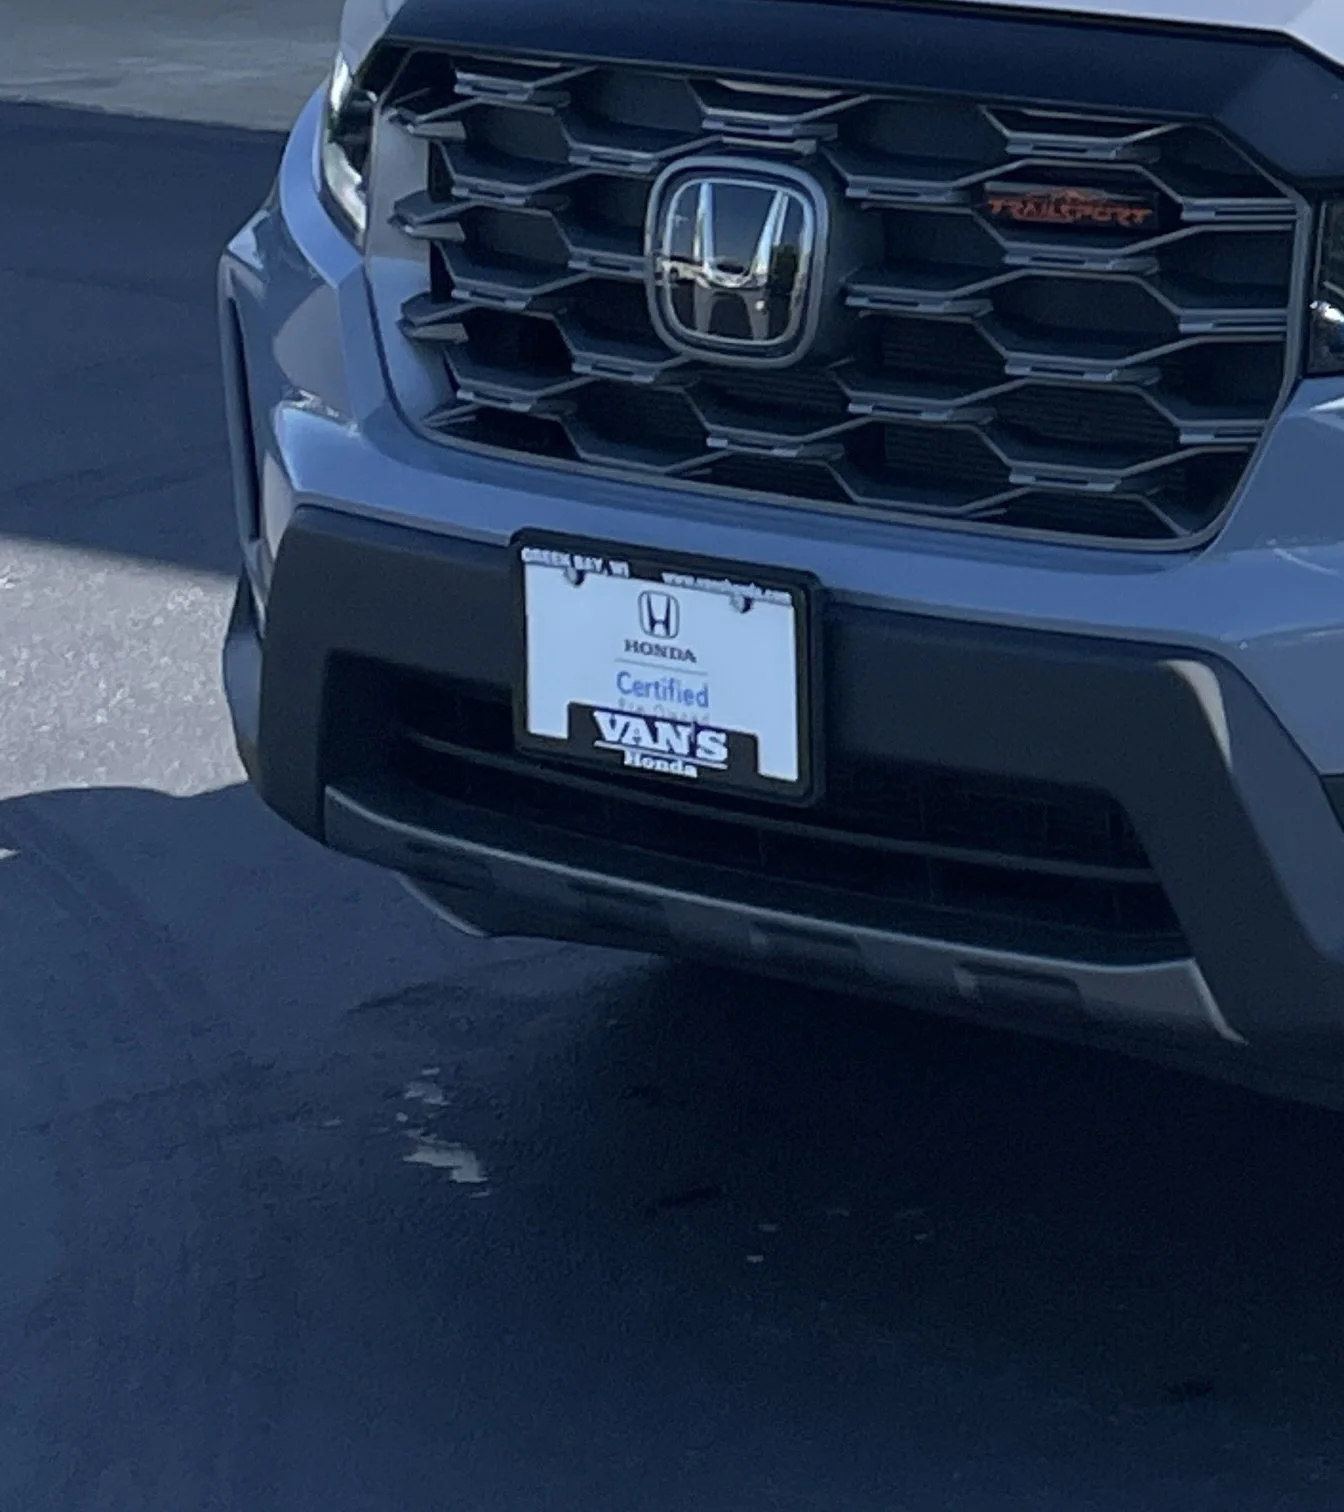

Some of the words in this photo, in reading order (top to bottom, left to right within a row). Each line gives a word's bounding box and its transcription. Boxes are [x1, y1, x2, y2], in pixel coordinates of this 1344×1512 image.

[623, 638, 698, 664] HONDA
[616, 670, 709, 708] Certified
[623, 748, 698, 779] Honda
